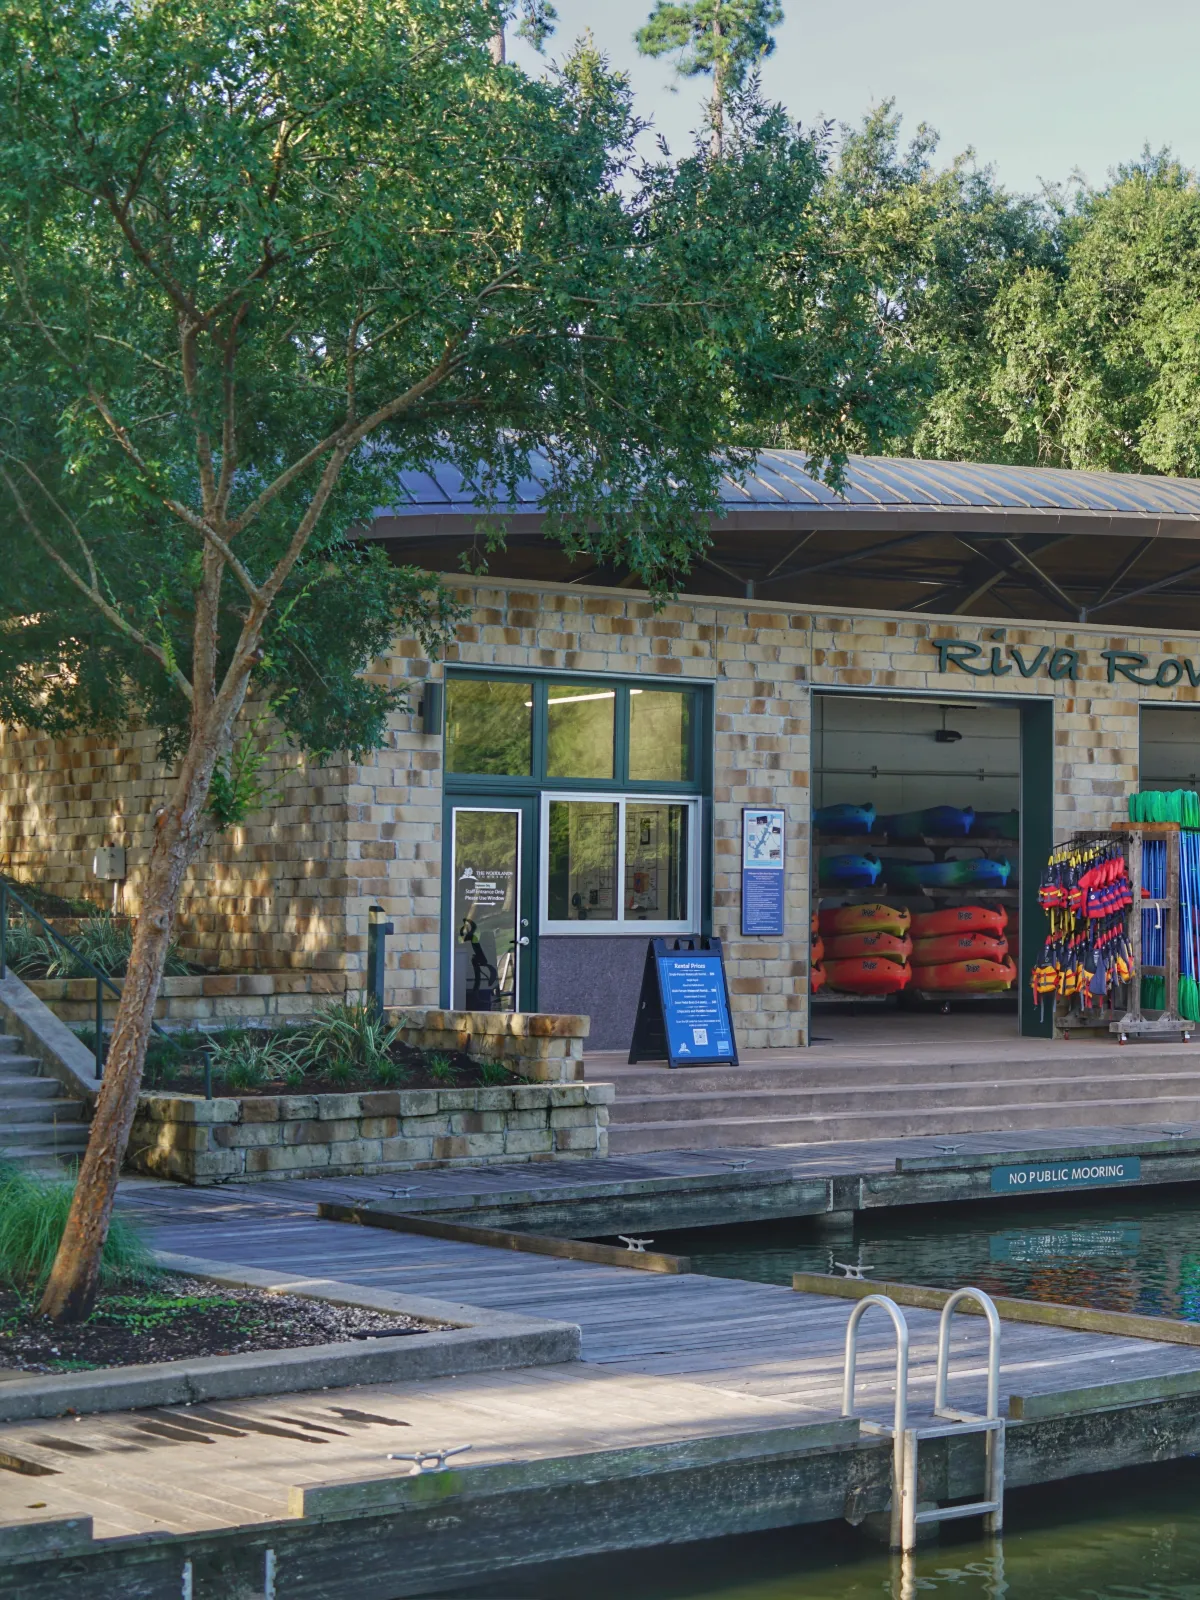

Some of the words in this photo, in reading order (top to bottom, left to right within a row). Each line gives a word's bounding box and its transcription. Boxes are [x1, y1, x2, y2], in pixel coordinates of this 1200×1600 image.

[932, 629, 1079, 681] Riva
[1009, 1172, 1027, 1184] NO
[1030, 1169, 1068, 1183] PUBLIC
[1072, 1165, 1124, 1180] MOORING
